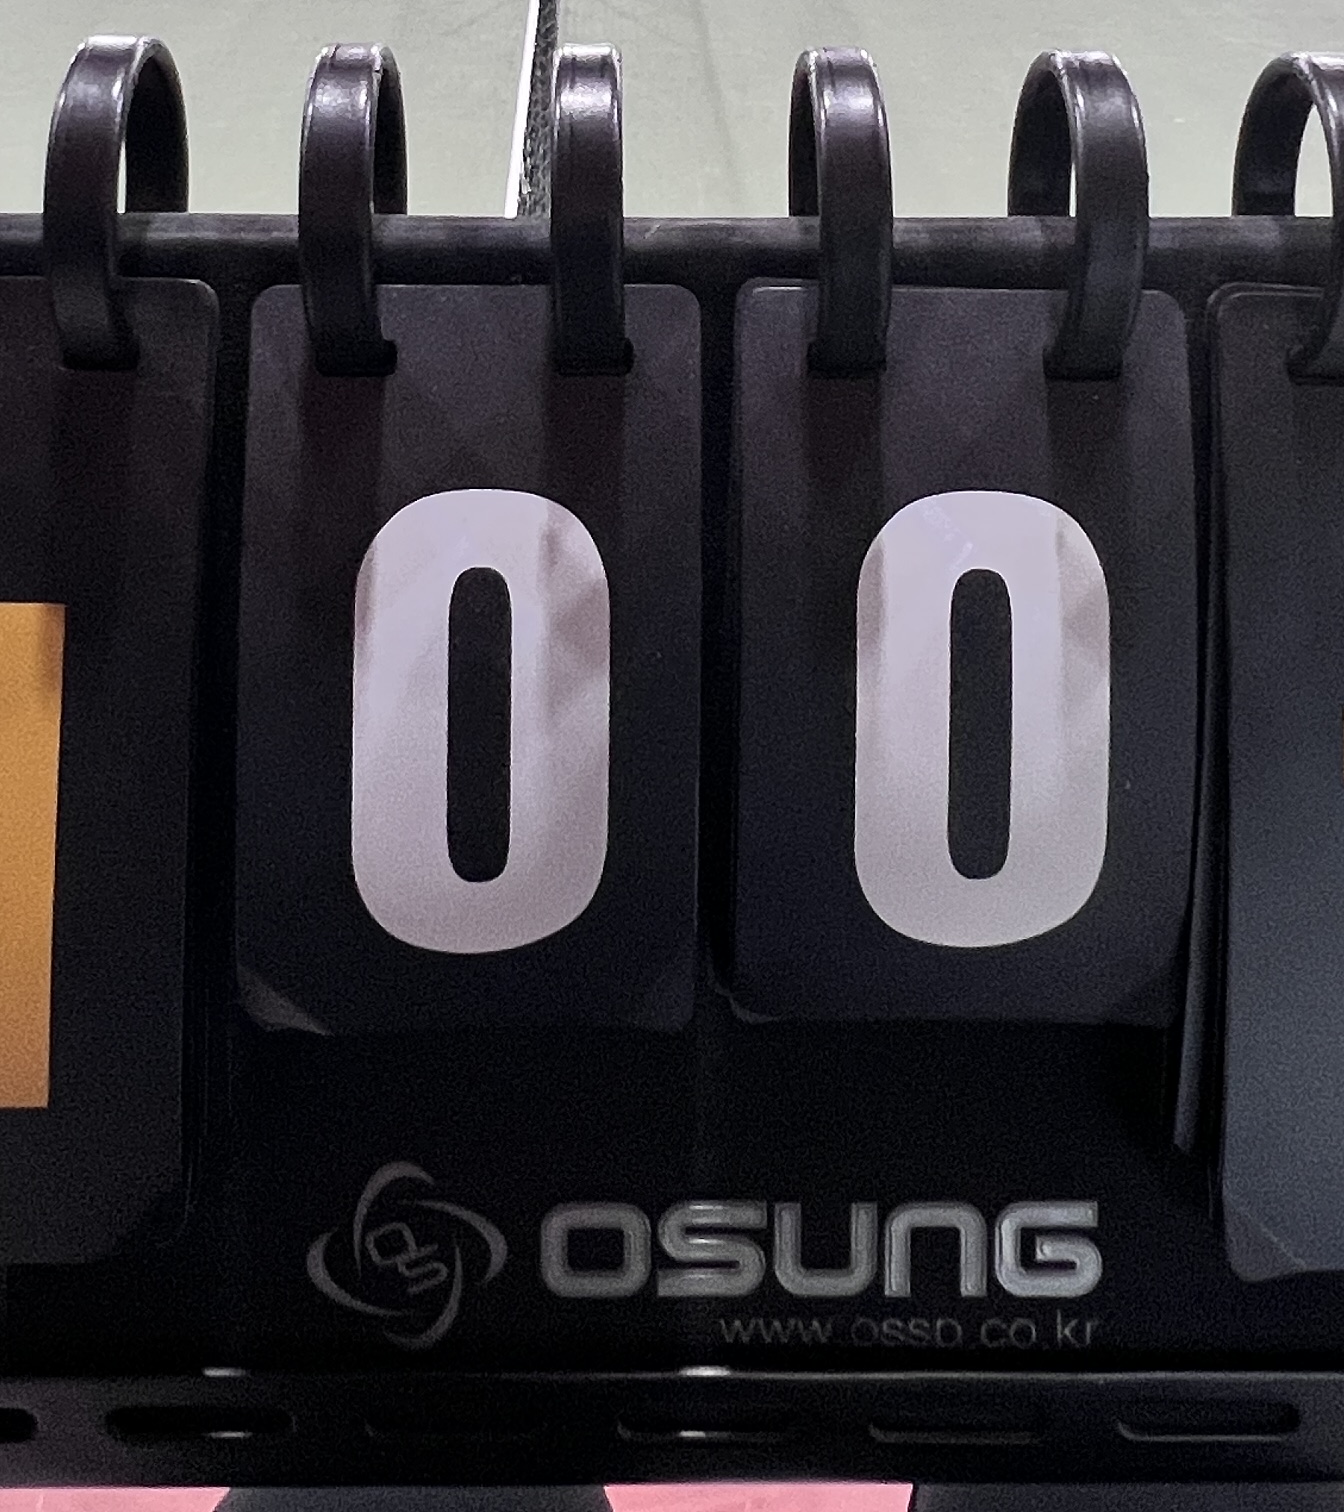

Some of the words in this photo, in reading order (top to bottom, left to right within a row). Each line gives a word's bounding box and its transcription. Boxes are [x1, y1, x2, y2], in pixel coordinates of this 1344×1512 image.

[351, 489, 611, 954] 0
[853, 491, 1110, 949] 0
[541, 1200, 1104, 1299] OSUNG
